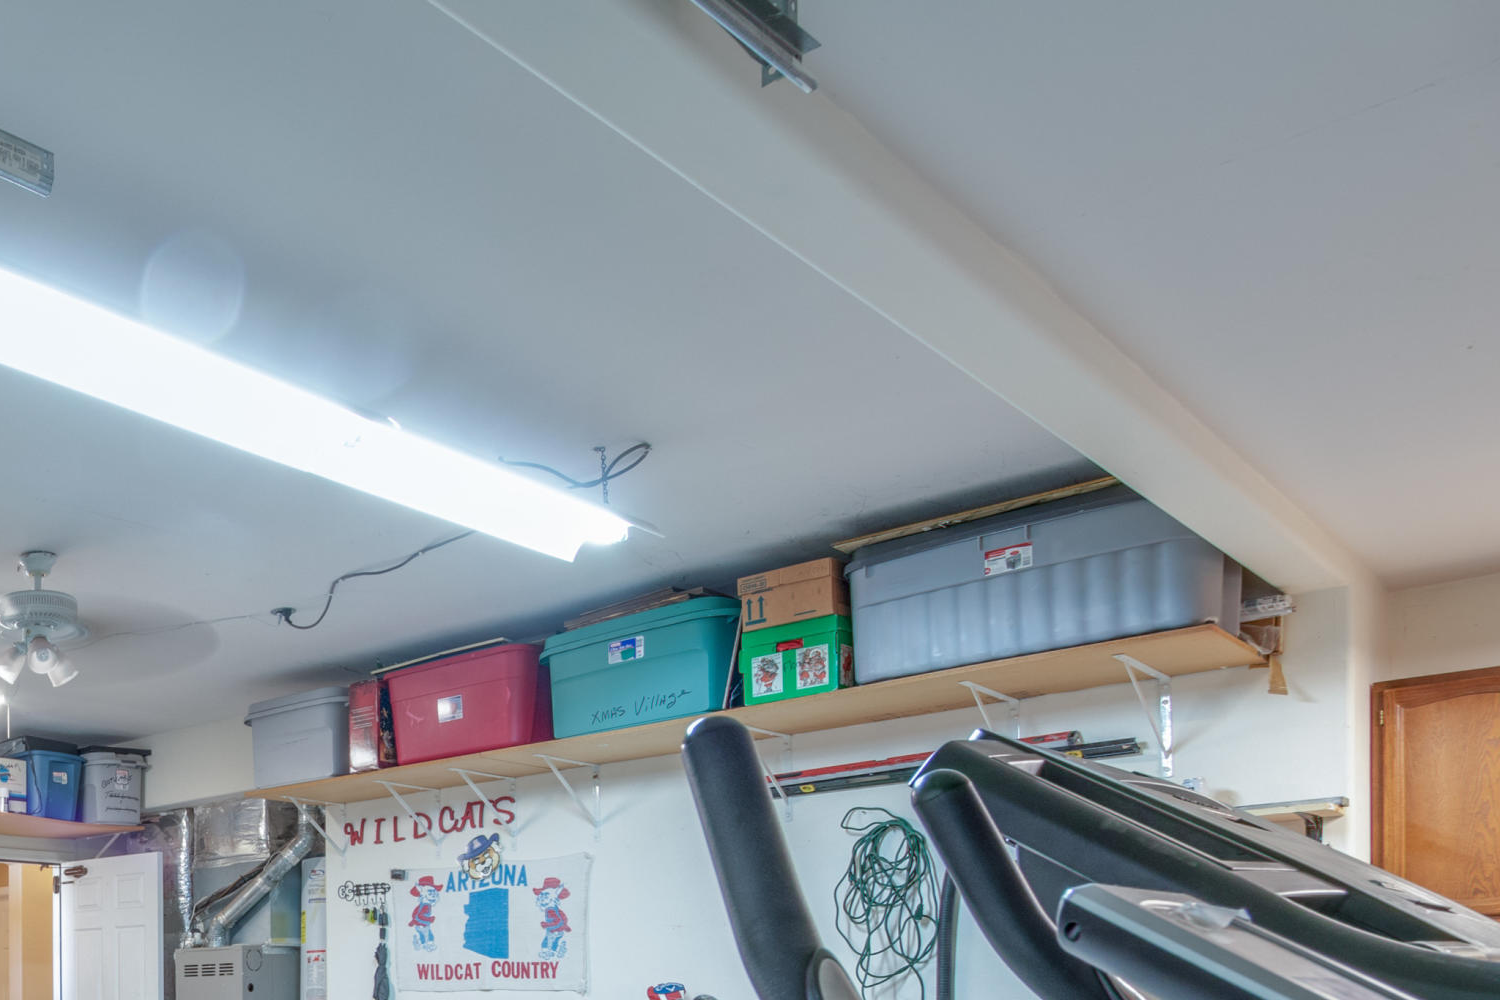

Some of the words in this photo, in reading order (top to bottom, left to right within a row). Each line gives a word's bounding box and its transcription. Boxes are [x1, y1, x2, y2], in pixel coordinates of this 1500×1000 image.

[591, 705, 626, 726] XMAS
[344, 795, 516, 846] WILDCATS
[417, 962, 482, 981] WILDCAT
[491, 960, 559, 980] COUNTRY
